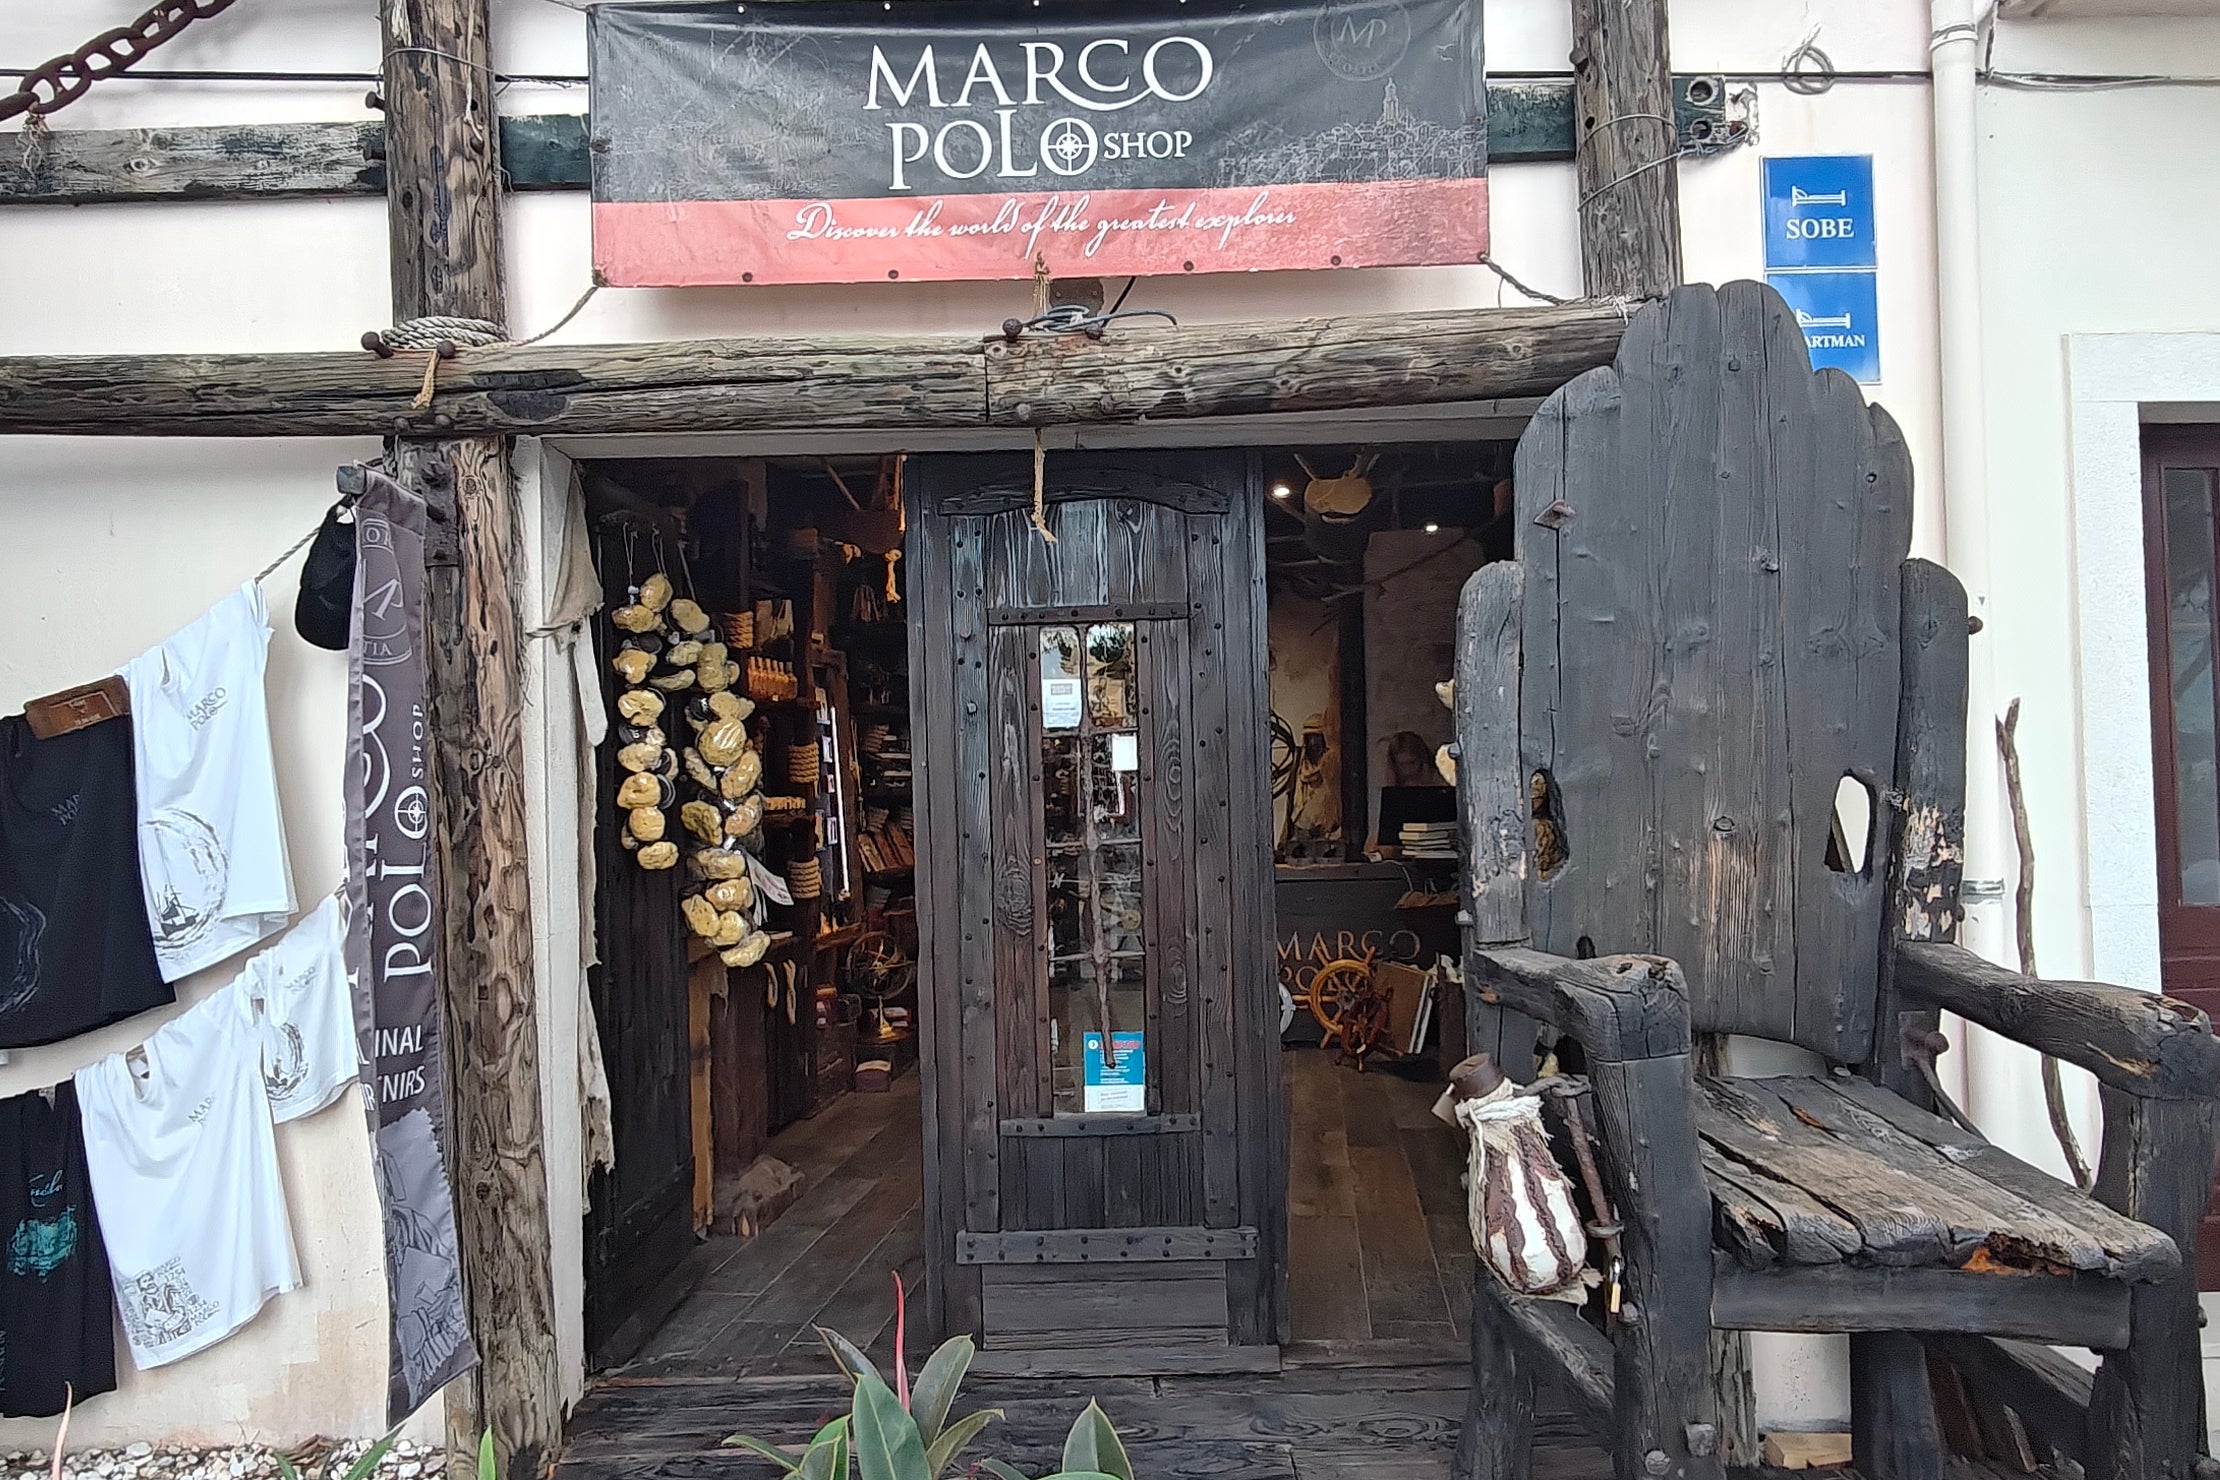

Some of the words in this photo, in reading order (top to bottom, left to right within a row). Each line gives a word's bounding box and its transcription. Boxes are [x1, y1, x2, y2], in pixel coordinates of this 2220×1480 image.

[863, 36, 1213, 111] MARCO
[886, 108, 1098, 190] POLO
[1103, 130, 1193, 159] SHOP
[787, 202, 898, 240] Discover
[904, 199, 944, 238] the
[947, 197, 1026, 236] world
[1021, 195, 1058, 260] of
[1052, 194, 1091, 232] the
[1084, 199, 1196, 258] greatest
[1195, 191, 1296, 250] explorer
[1786, 217, 1855, 240] SOBE
[382, 785, 434, 983] POLO
[410, 703, 424, 780] SHOP
[1277, 930, 1421, 962] MARCO
[378, 1065, 426, 1103] NIRS
